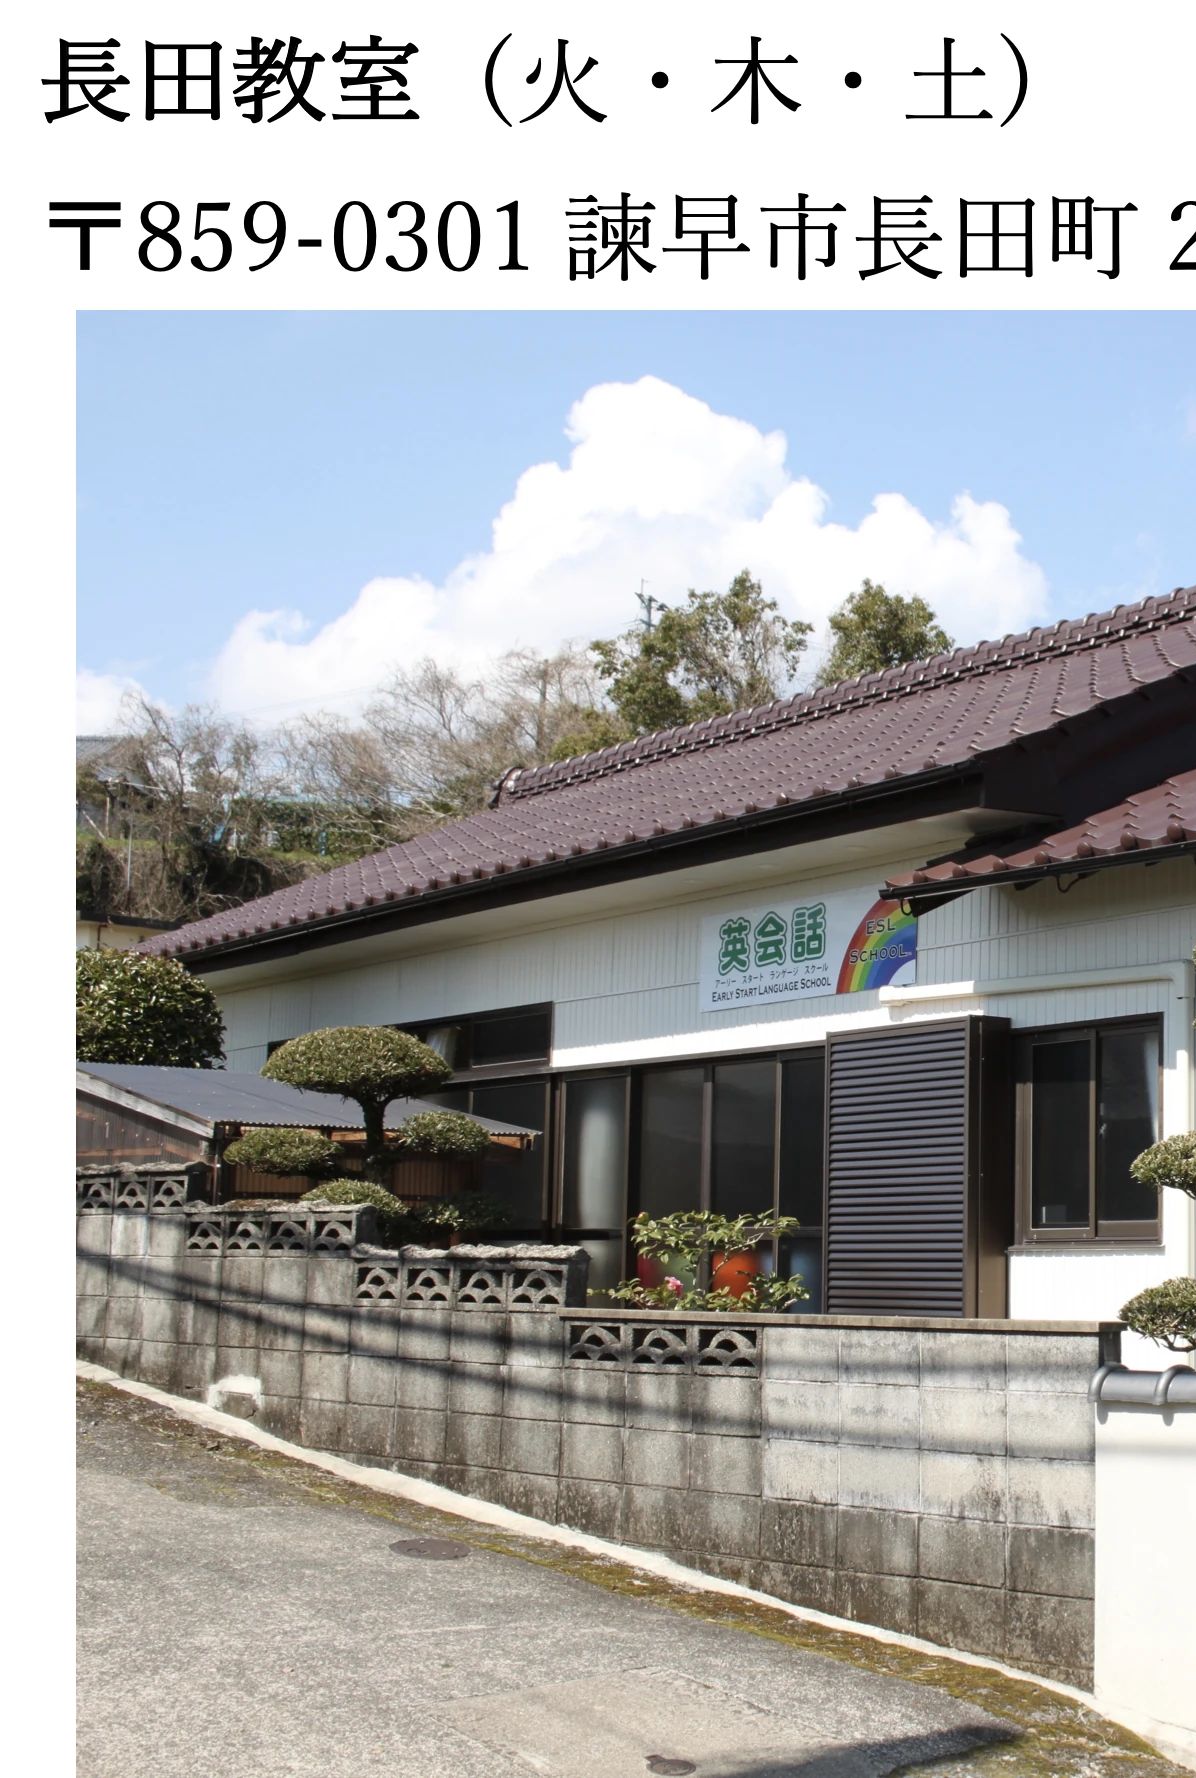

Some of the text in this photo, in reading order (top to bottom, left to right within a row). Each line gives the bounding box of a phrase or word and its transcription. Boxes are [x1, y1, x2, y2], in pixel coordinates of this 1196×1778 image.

[866, 917, 896, 935] ESL
[719, 902, 827, 976] 英会話
[849, 944, 907, 964] SCHOOL
[742, 972, 764, 984] スタート
[804, 963, 829, 975] スクール
[712, 977, 832, 1002] EARLY START LANGUAGE SCHOOL
